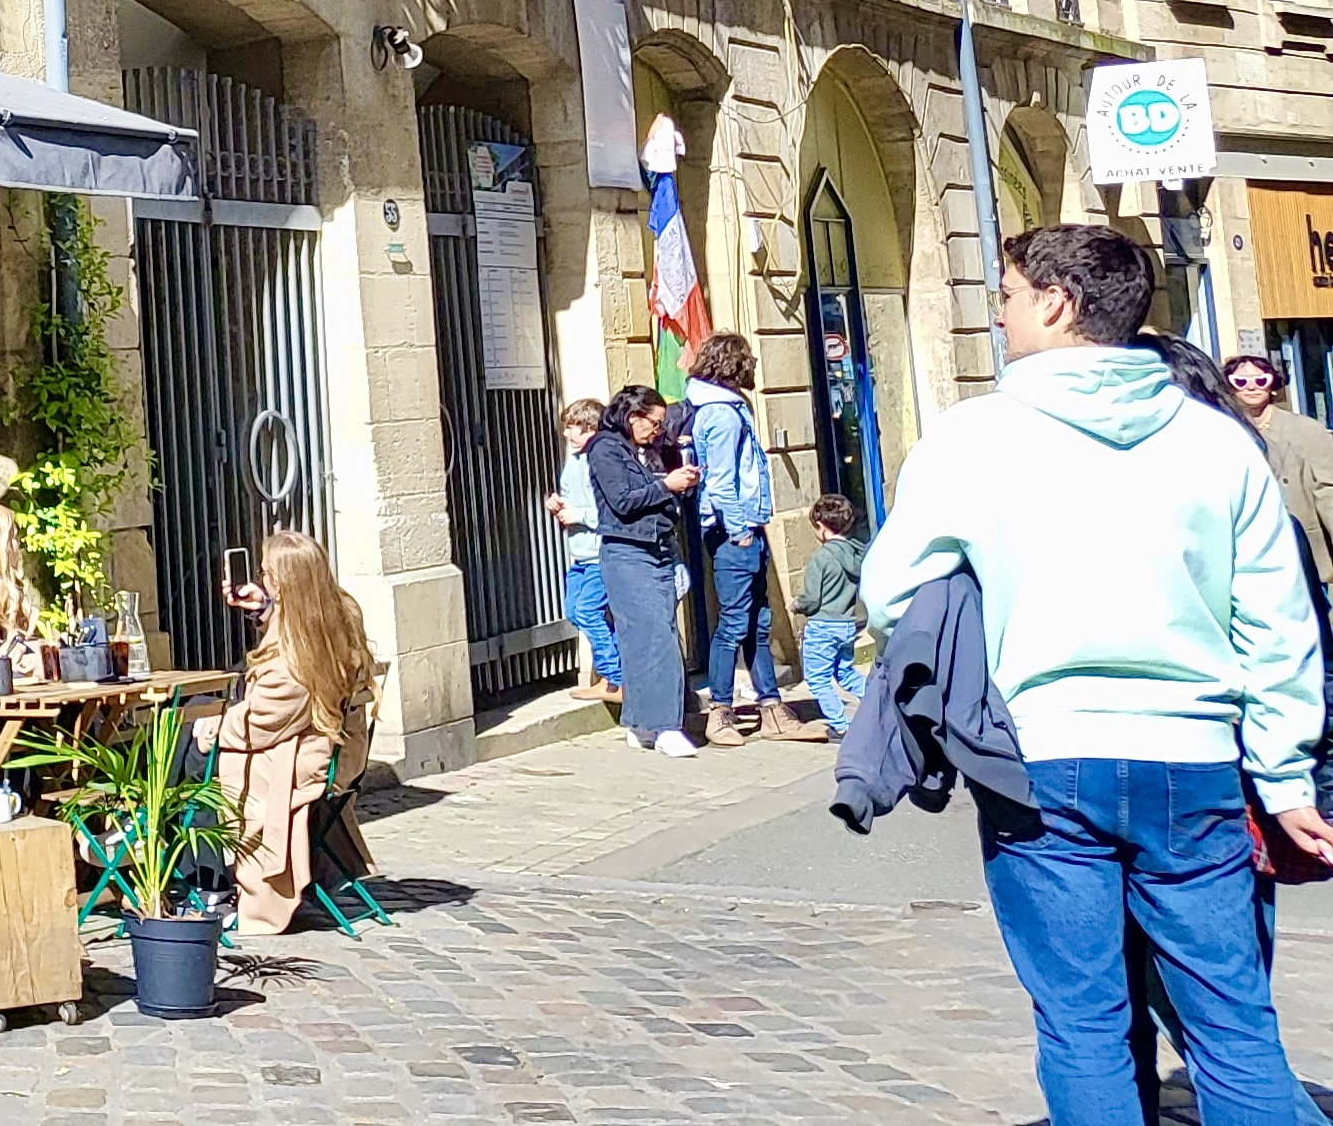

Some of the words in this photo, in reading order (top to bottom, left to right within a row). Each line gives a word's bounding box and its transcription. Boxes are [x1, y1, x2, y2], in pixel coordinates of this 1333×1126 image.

[1096, 74, 1142, 117] AUTOUR
[1156, 74, 1176, 91] DE
[1180, 93, 1198, 111] LA
[1119, 101, 1180, 135] BD
[1105, 167, 1151, 178] ACHAT
[1158, 163, 1205, 175] VENTE
[384, 201, 399, 223] 55
